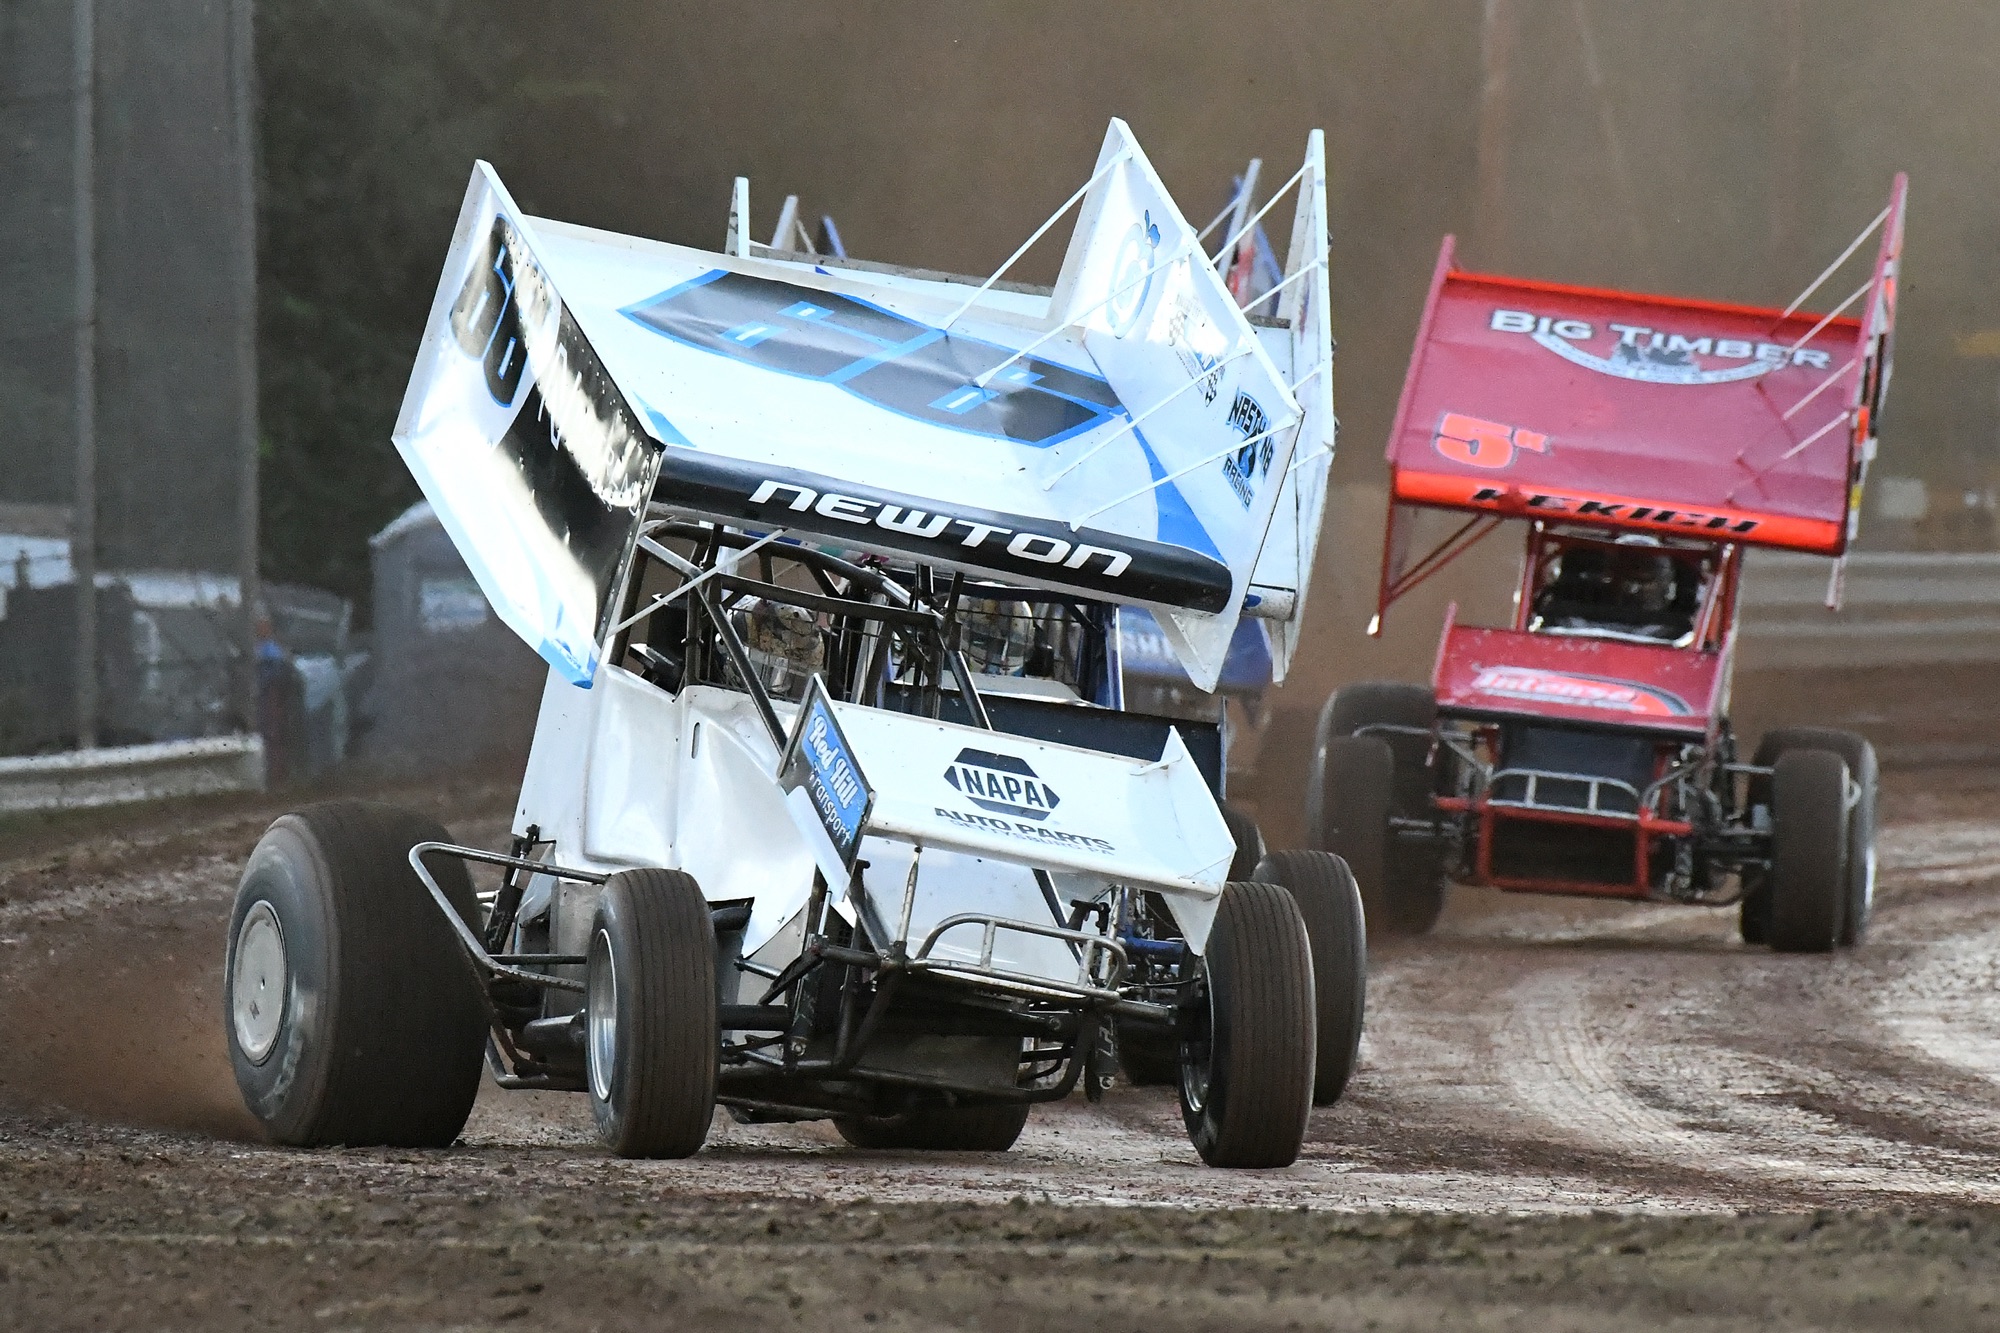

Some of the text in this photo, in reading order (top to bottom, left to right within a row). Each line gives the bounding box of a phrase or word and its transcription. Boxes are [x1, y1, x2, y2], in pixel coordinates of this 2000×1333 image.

[1489, 309, 1594, 341] BIG
[1609, 323, 1831, 370] TIMBER
[1228, 395, 1267, 435] NASTY
[1223, 457, 1254, 508] RACING
[807, 716, 860, 810] Red Hill
[961, 767, 1045, 808] NAPA
[809, 761, 852, 846] Transport
[934, 807, 1116, 851] AUTO PARTS
